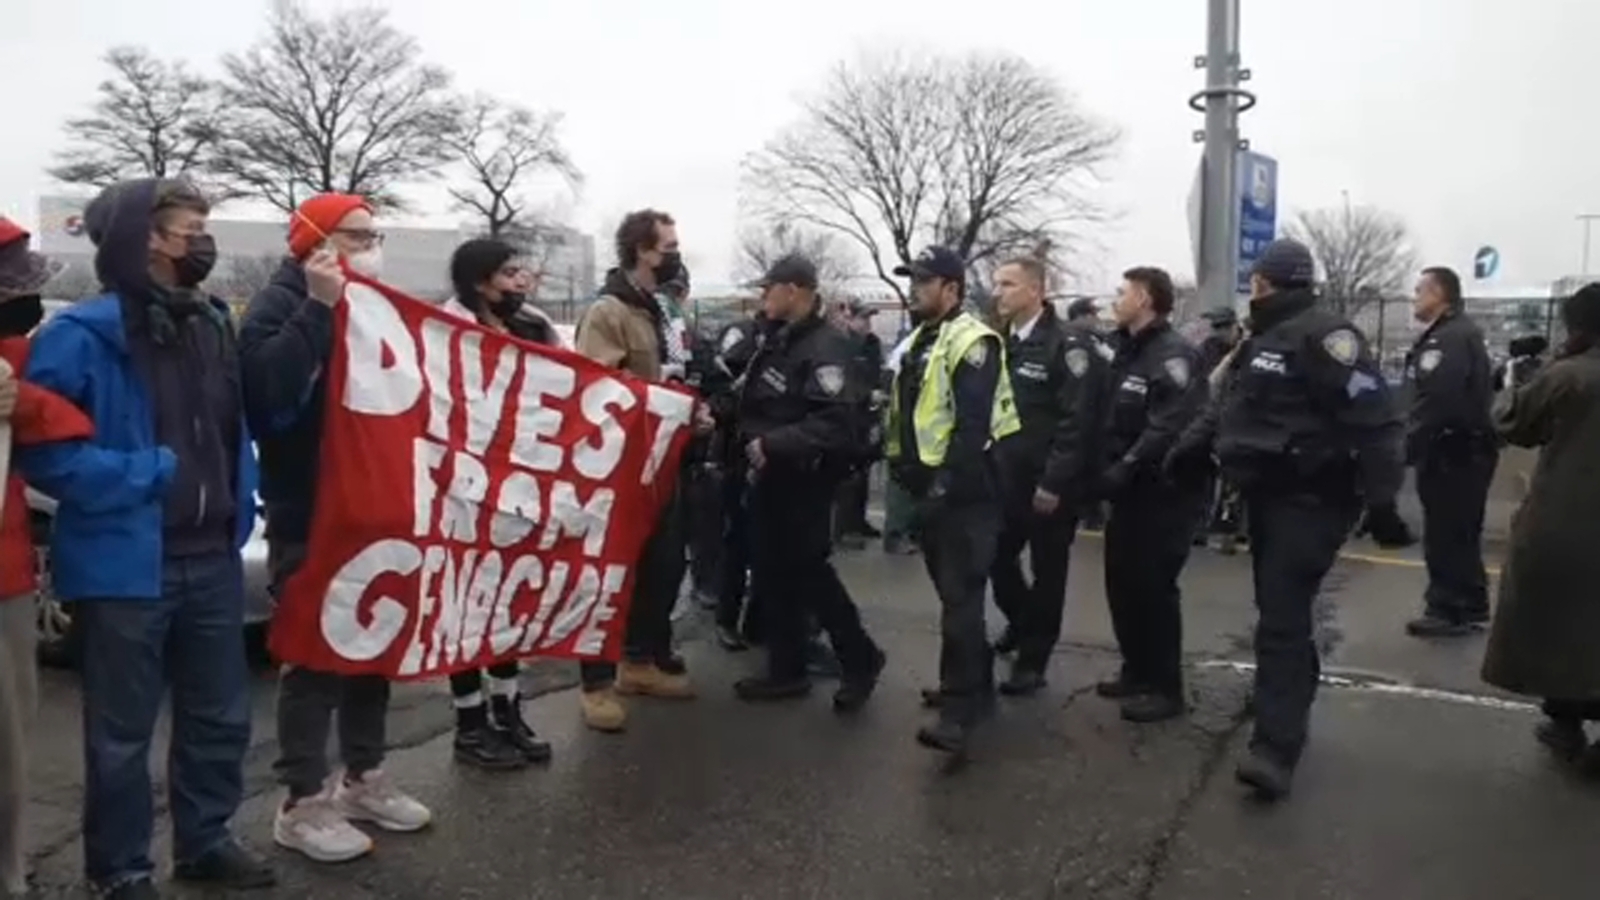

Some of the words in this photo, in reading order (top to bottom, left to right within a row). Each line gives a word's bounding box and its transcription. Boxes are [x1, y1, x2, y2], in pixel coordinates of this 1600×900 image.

[342, 280, 695, 485] DIVEST
[413, 436, 614, 557] FROM
[320, 538, 626, 675] GENOCIDE
